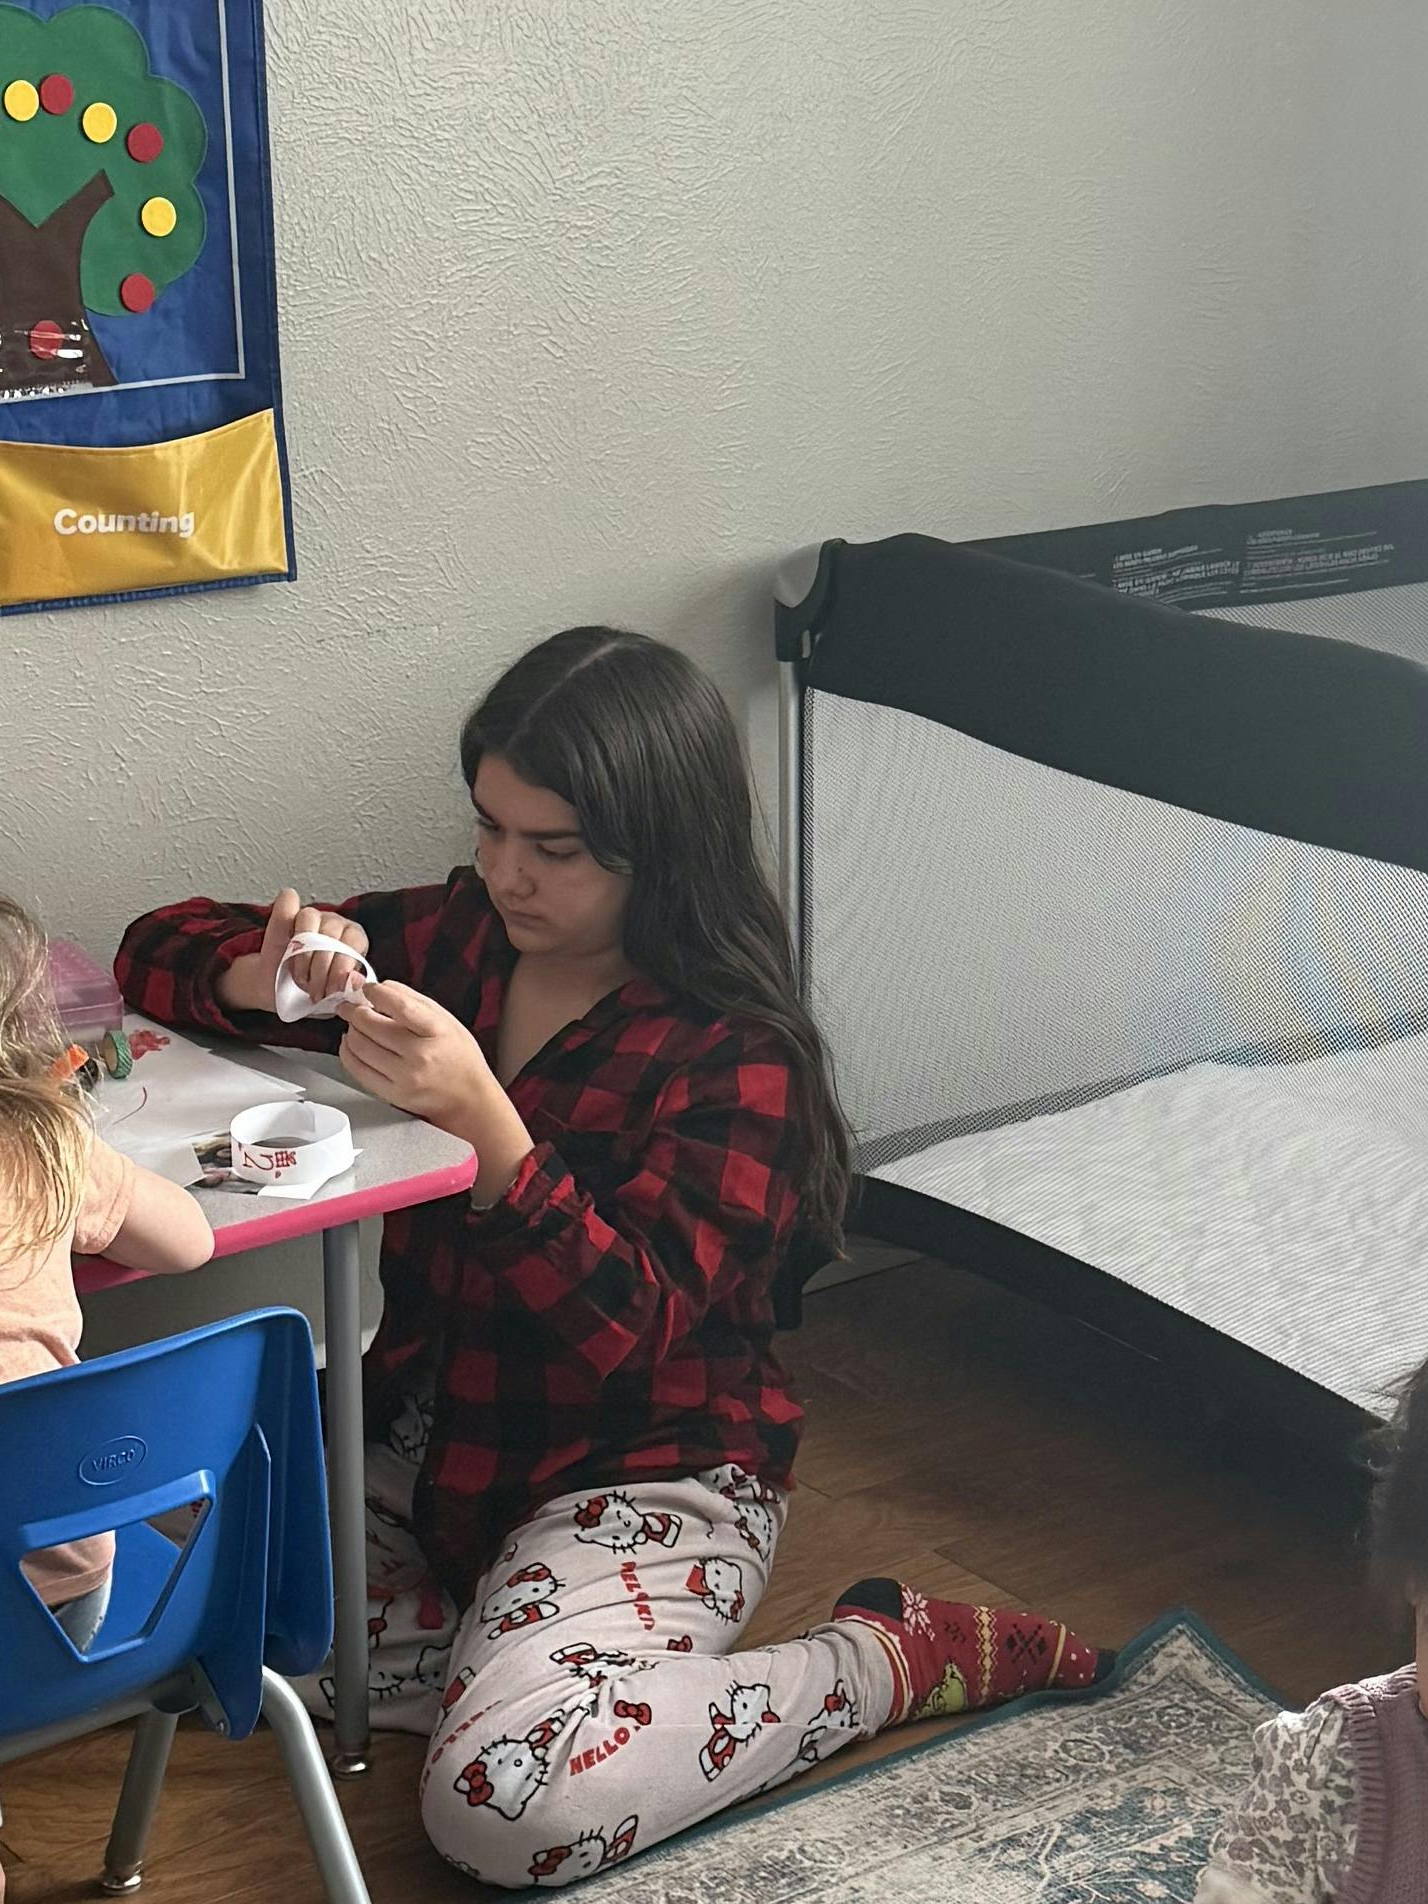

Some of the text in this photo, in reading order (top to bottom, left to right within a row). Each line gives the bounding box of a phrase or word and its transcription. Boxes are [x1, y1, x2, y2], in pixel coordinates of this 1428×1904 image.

[53, 508, 196, 539] Counting
[92, 1448, 136, 1472] VIRCO
[569, 1726, 631, 1777] HELLO
